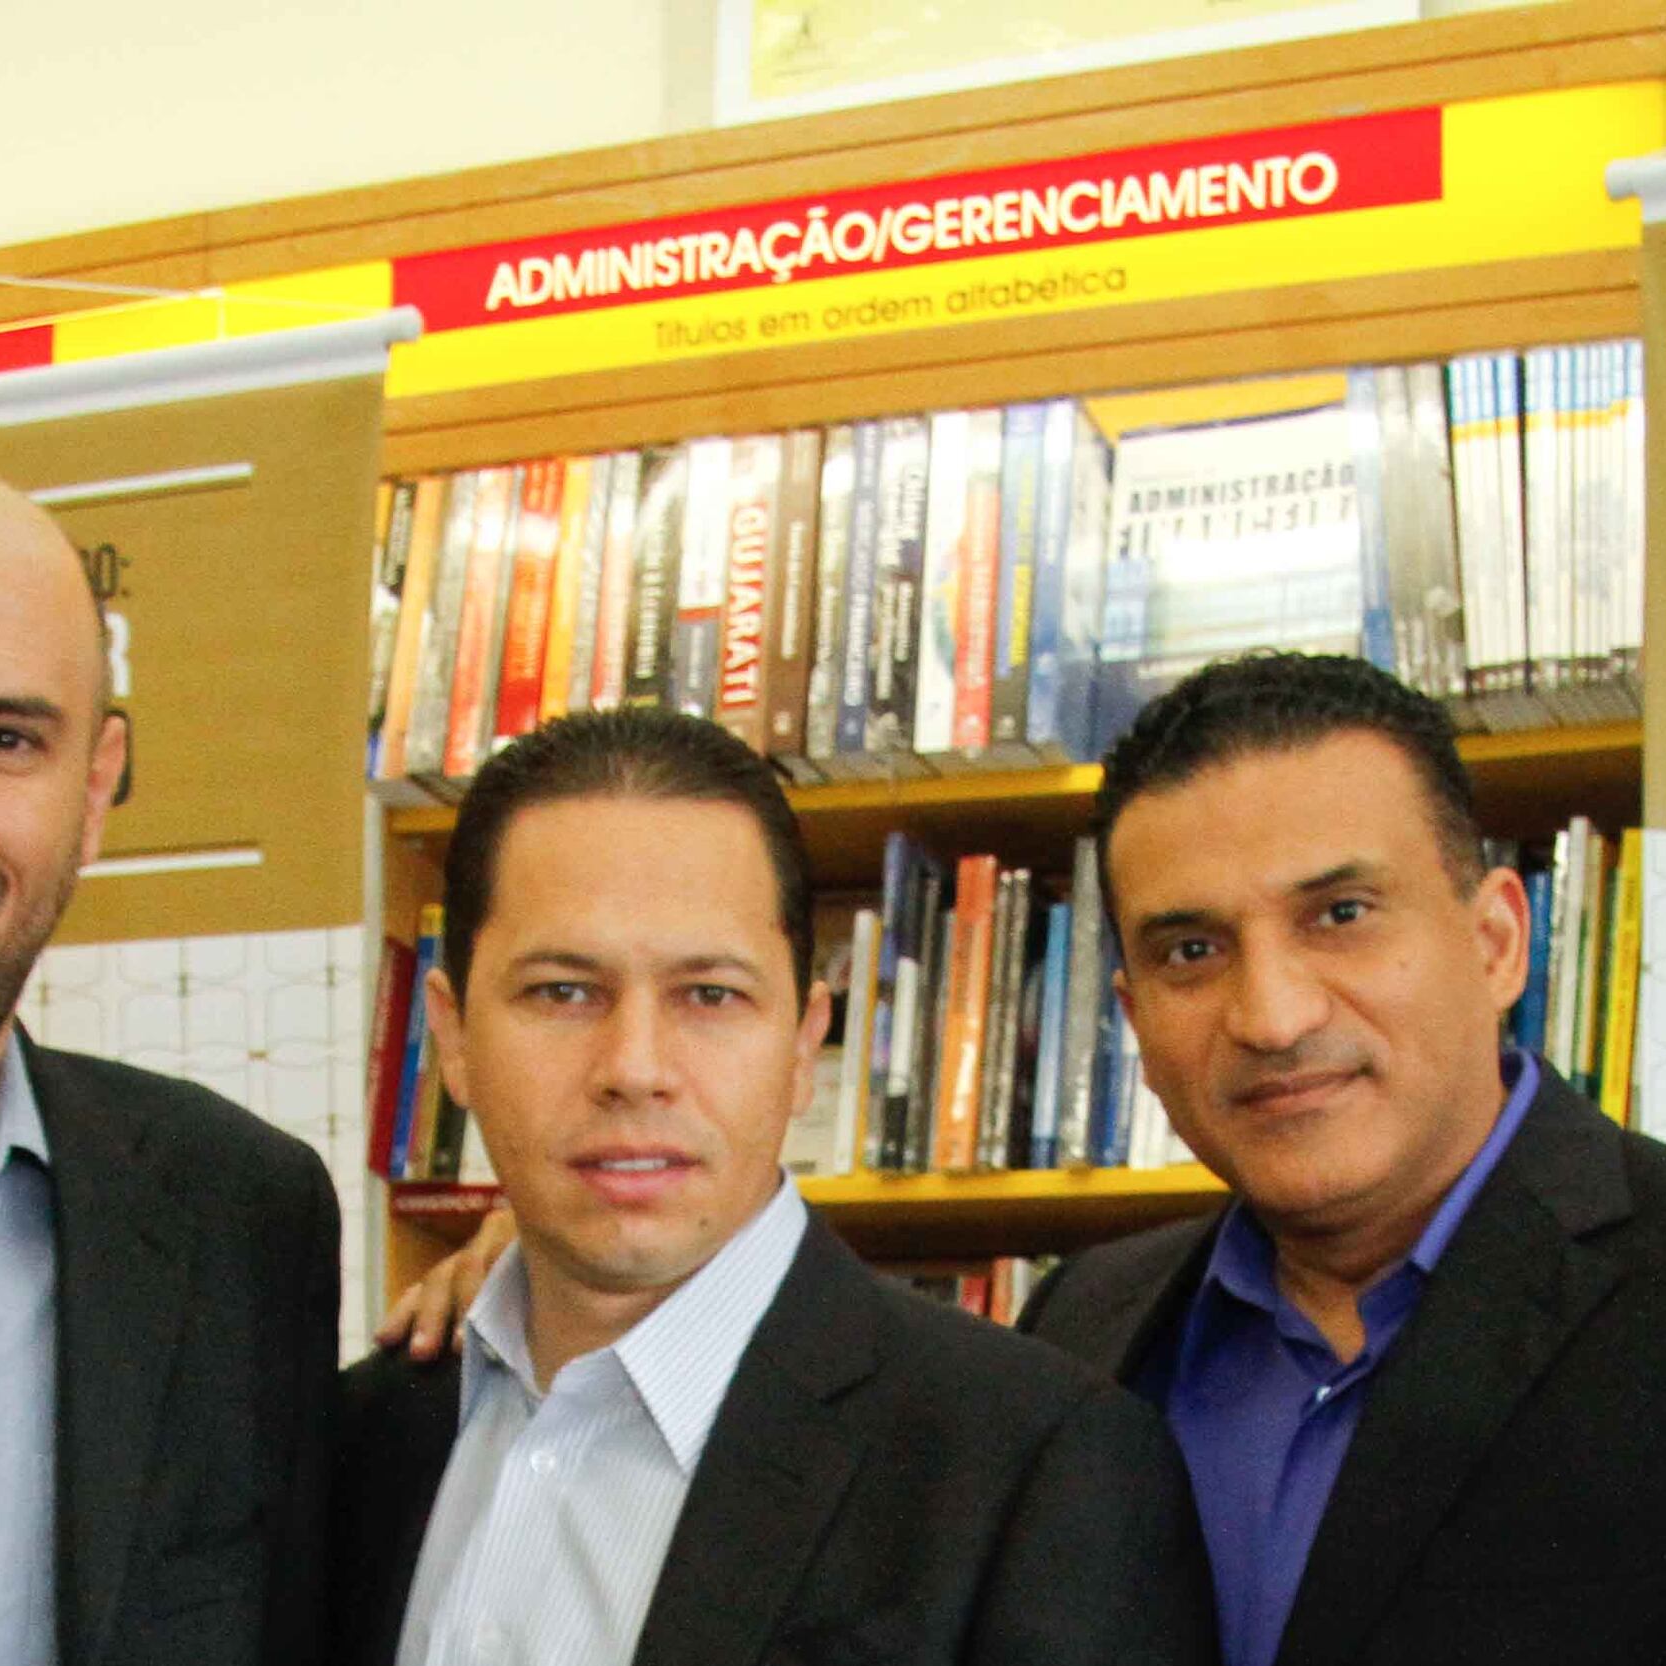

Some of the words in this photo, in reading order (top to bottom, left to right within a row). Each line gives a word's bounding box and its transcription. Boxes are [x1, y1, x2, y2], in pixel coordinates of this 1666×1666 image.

[485, 151, 1338, 311] ADMINISTRAÇÃO/GERENCIAMENTO
[758, 310, 811, 338] em
[821, 288, 934, 330] ordem
[1129, 460, 1356, 513] ADMINISTRAÇÃO
[722, 498, 770, 711] GUJARATI
